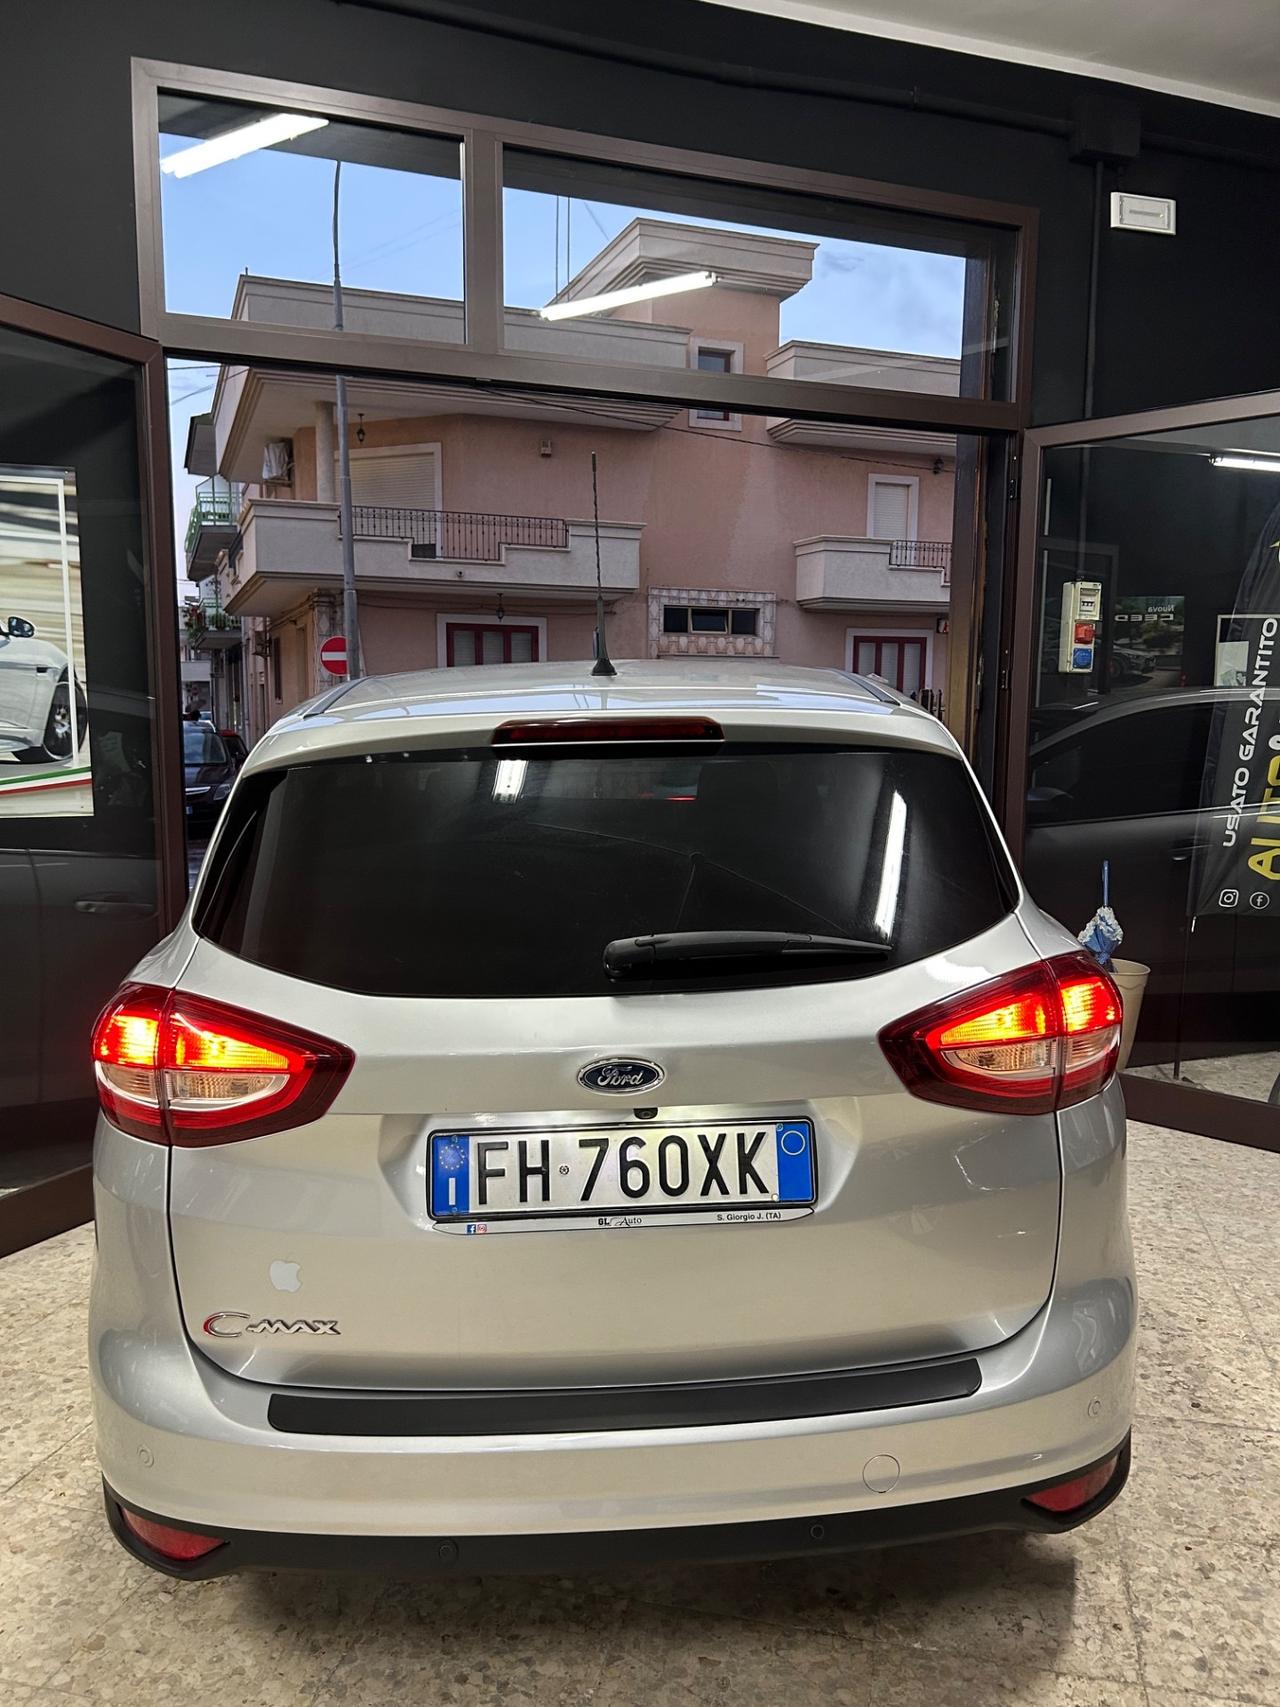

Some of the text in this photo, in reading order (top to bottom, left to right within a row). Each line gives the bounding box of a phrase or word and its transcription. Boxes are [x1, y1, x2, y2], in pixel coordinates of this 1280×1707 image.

[1222, 618, 1278, 847] USATO GARANTITO
[597, 1065, 645, 1086] Ford
[476, 1131, 770, 1206] FH 760XK
[598, 1217, 610, 1226] GL
[726, 1213, 756, 1222] Giorgio
[756, 1212, 764, 1220] J.
[765, 1211, 782, 1220] (TA)
[203, 1311, 342, 1338] C-MAX
